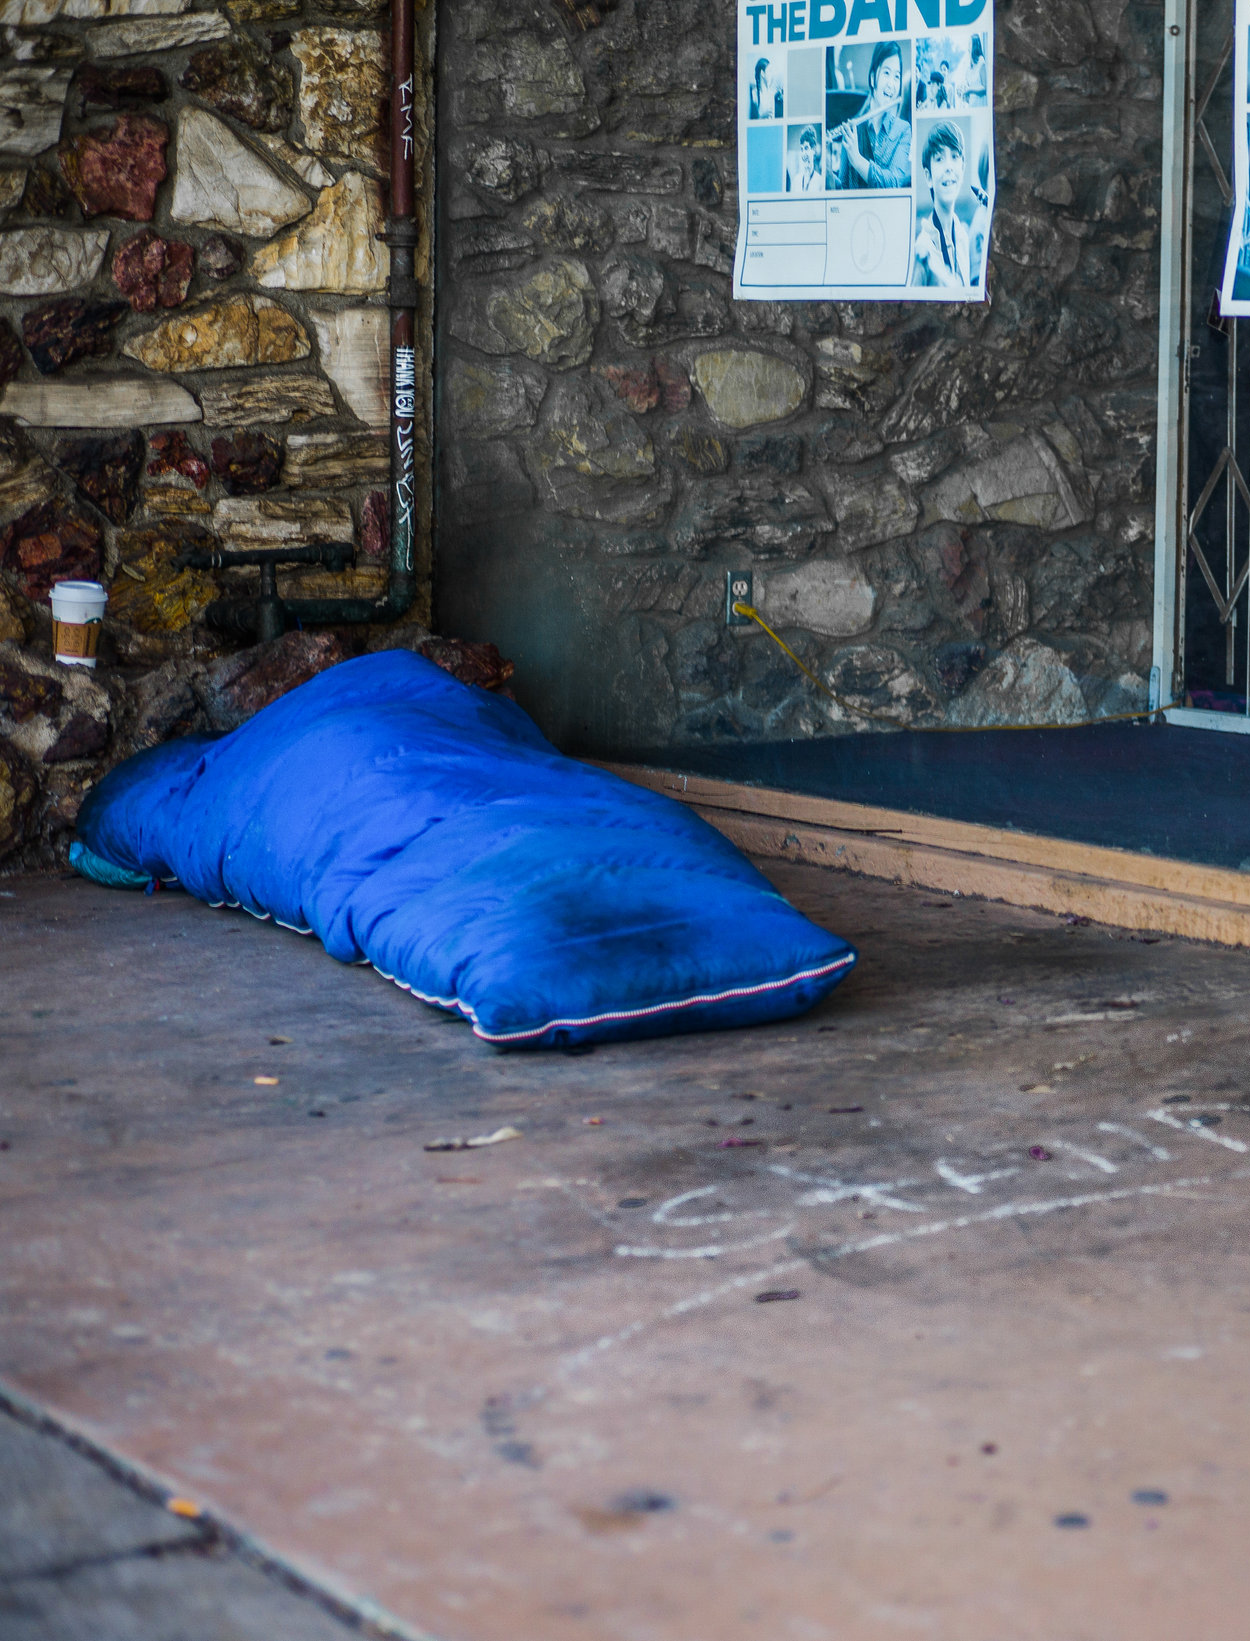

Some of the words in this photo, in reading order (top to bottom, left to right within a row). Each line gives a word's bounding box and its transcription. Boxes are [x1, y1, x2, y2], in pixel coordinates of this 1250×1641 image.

[746, 1, 806, 45] THE
[395, 347, 415, 387] THANK
[395, 389, 415, 418] YOU
